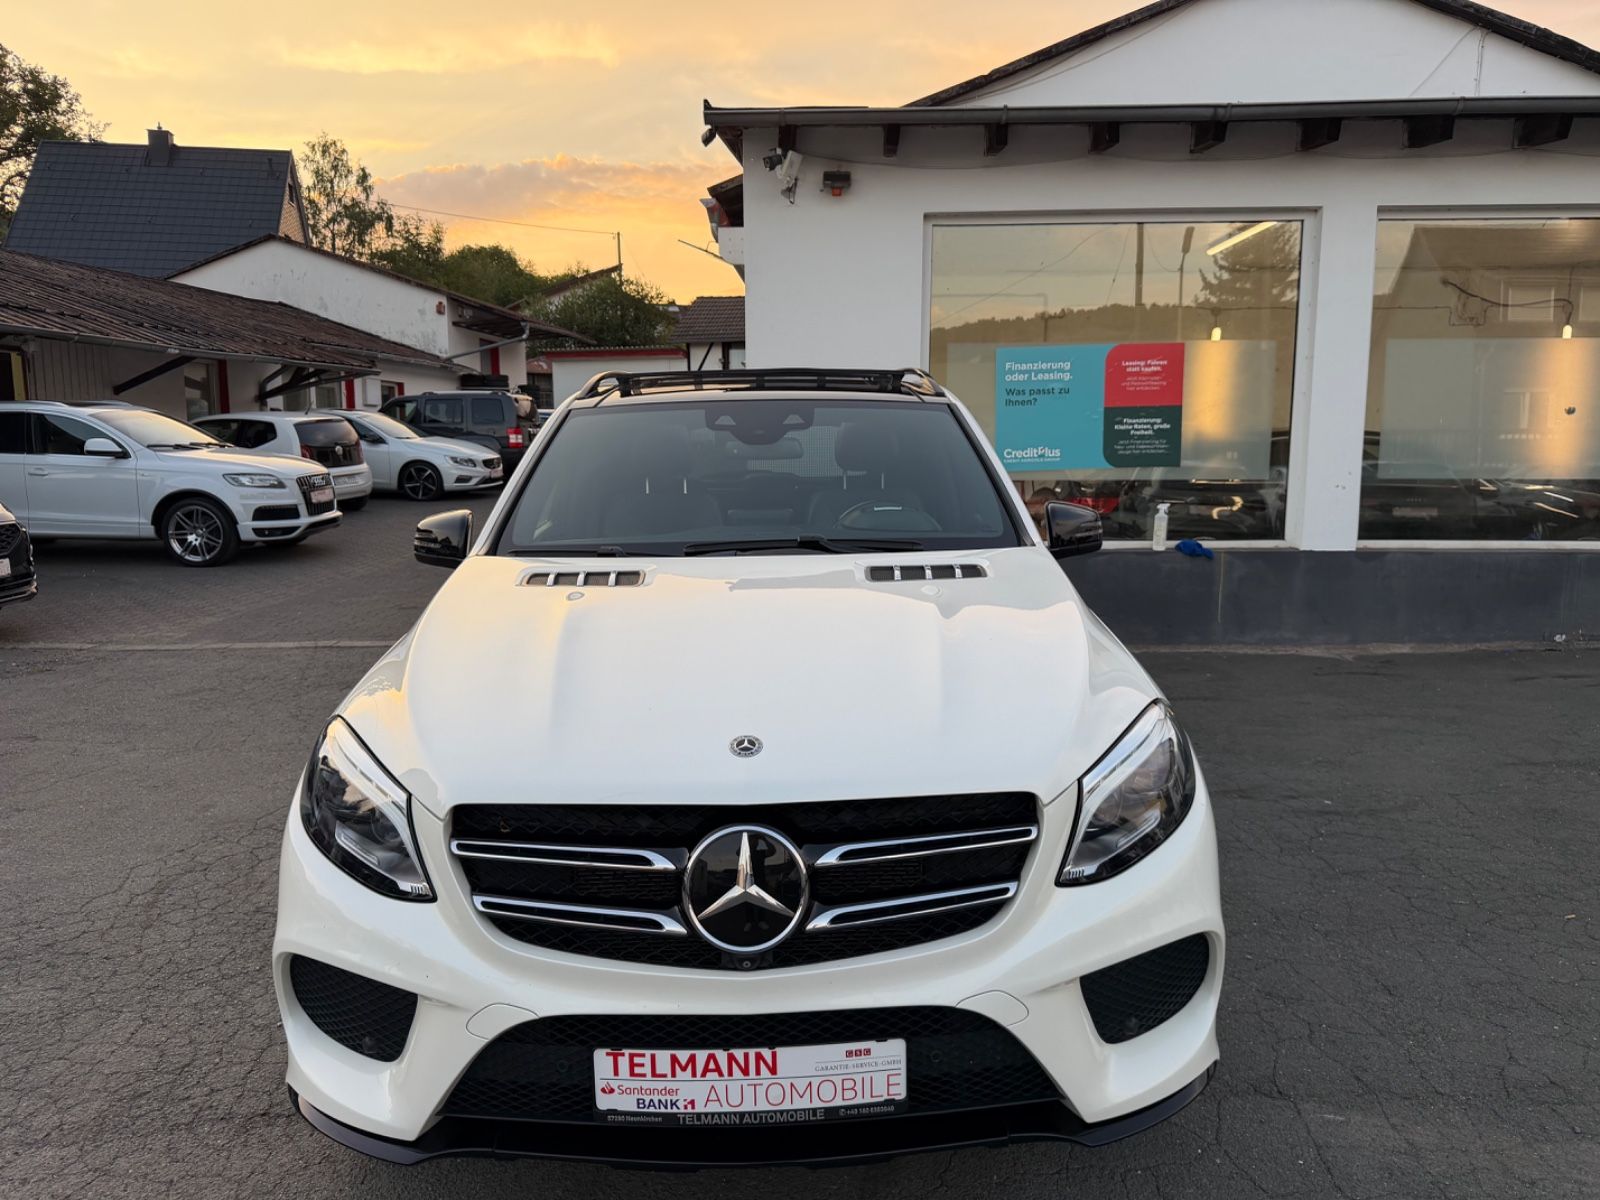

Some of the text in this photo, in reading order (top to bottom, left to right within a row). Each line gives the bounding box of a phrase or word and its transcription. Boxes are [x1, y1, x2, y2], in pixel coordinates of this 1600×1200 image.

[1005, 361, 1071, 371] Finanzierung
[1005, 371, 1073, 381] oder Leasing.
[1005, 387, 1070, 396] Was passt zu
[1005, 398, 1038, 407] Ihnen?
[605, 1051, 778, 1078] TELMANN
[617, 1084, 680, 1096] Santander
[704, 1073, 902, 1108] AUTOMOBILE
[677, 1109, 825, 1125] TELMANN AUTOMOBILE
